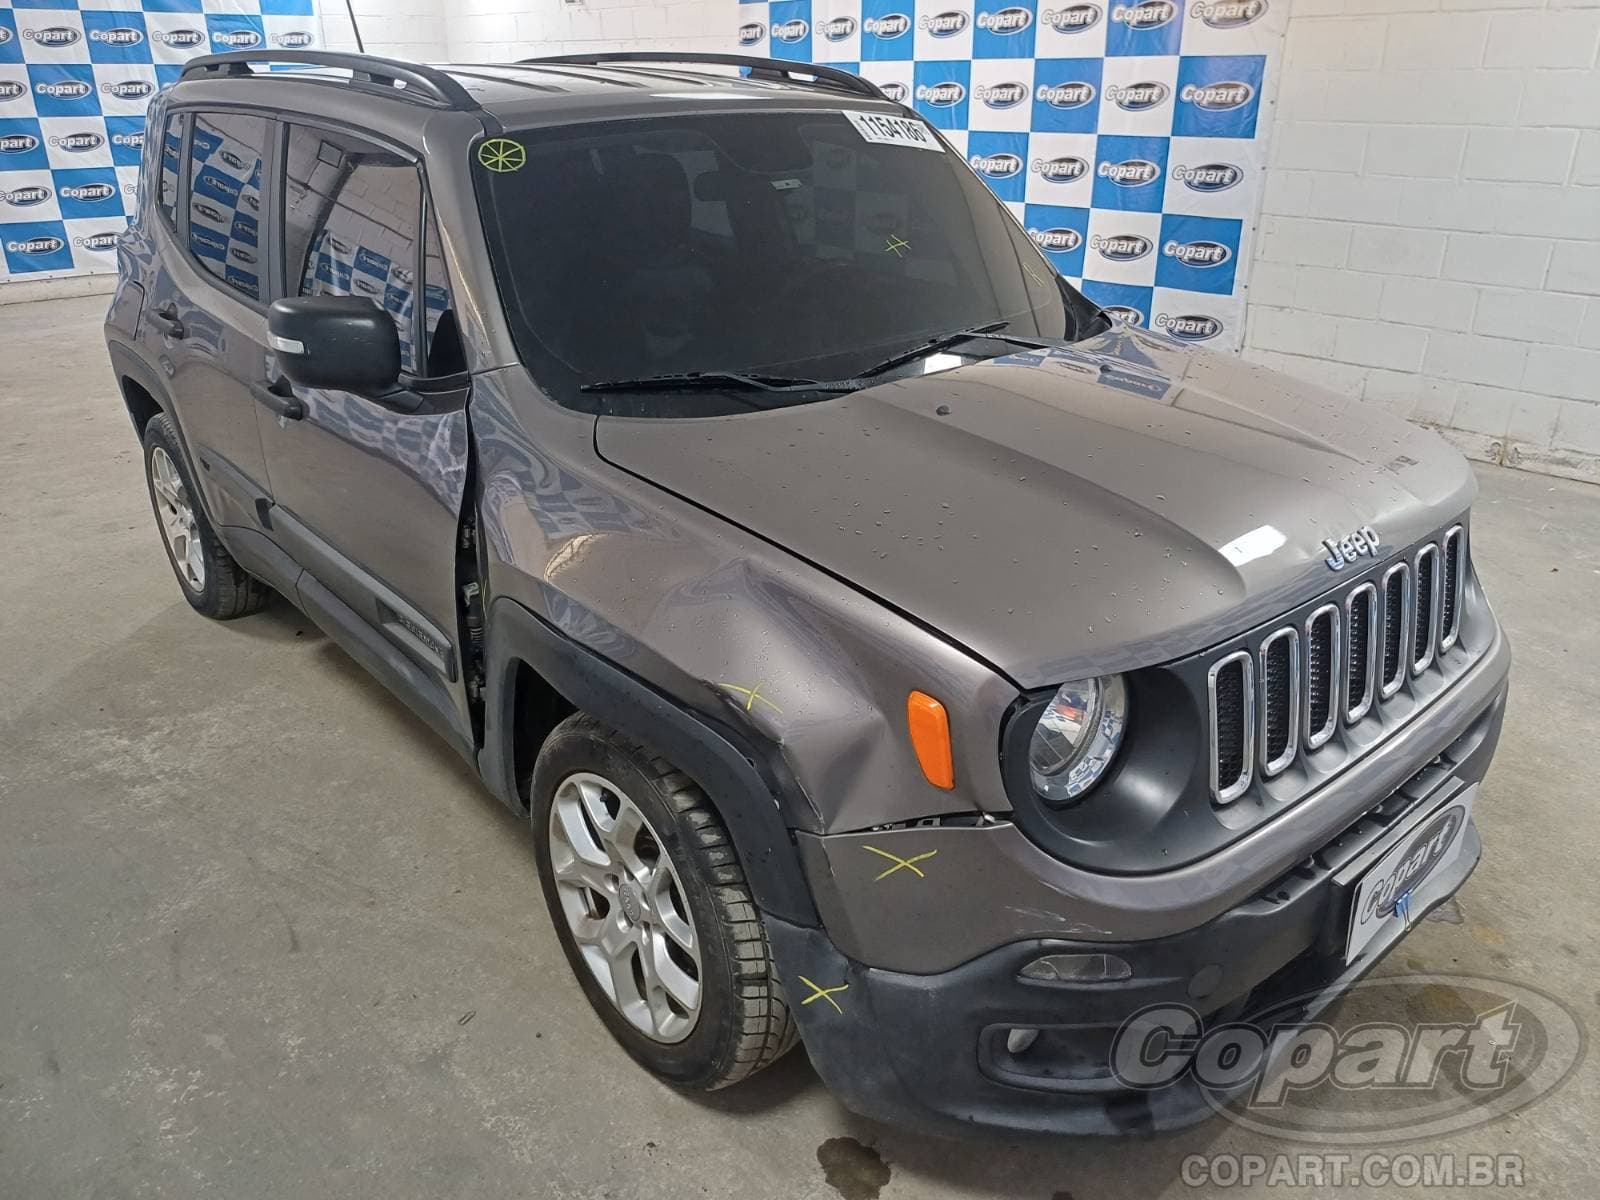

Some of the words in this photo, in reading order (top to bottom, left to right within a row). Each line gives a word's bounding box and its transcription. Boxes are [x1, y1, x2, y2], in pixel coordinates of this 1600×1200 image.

[977, 11, 1027, 31] Copart
[1041, 8, 1093, 29] Copart
[1113, 4, 1170, 27] Copart
[1190, 1, 1257, 23] Copart
[771, 23, 804, 39] Copart
[816, 20, 853, 38] Copart
[864, 17, 906, 34] Copart
[919, 14, 963, 33] Copart
[23, 28, 73, 43] Copart
[90, 29, 137, 43] Copart
[152, 30, 199, 44] Copart
[212, 31, 257, 46] Copart
[270, 33, 311, 46] Copart
[739, 27, 762, 40] part
[36, 83, 86, 97] Copart
[101, 82, 149, 97] Copart
[916, 85, 961, 103] Copart
[975, 86, 1022, 105] Copart
[1036, 85, 1091, 104] Copart
[1105, 85, 1160, 105] Copart
[1180, 85, 1246, 106] Copart
[859, 115, 927, 142] 1154186
[0, 137, 33, 151] part
[49, 135, 97, 150] Copart
[970, 155, 1017, 172] Copart
[1031, 158, 1082, 177] Copart
[1098, 161, 1151, 181] Copart
[1172, 165, 1234, 185] Copart
[60, 186, 110, 200] Copart
[7, 239, 58, 253] Copart
[73, 235, 119, 249] Copart
[1090, 234, 1145, 254] Copart
[1164, 240, 1223, 260] Copart
[1155, 313, 1214, 334] Copart
[1322, 525, 1380, 572] Jeep
[1360, 814, 1454, 926] Copart
